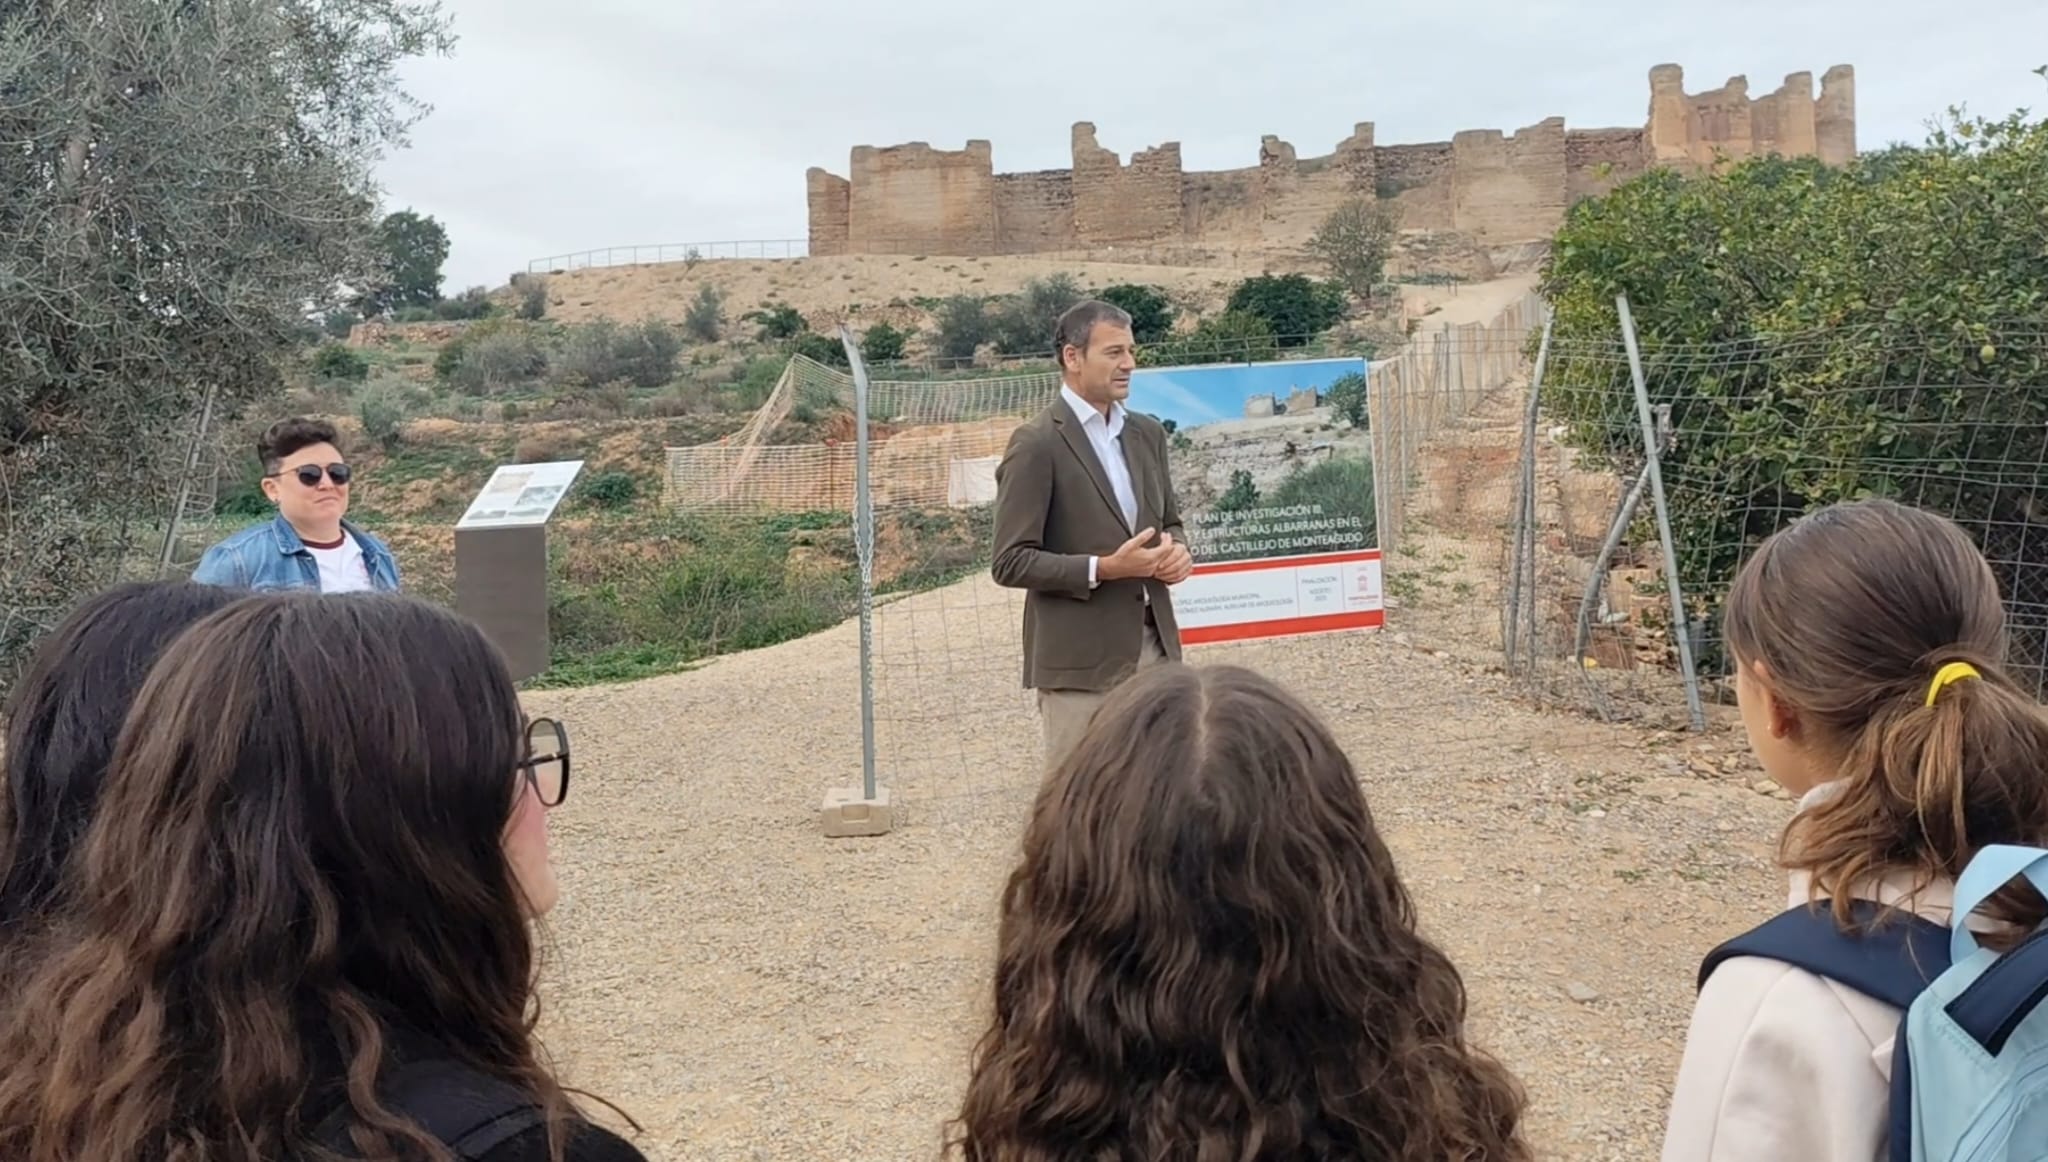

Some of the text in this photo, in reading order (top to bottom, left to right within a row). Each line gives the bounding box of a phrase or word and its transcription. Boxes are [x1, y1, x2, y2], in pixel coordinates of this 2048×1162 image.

[1192, 511, 1218, 524] PLAN
[1220, 510, 1235, 522] DE
[1235, 503, 1311, 520] INVESTIGACIÓN
[1192, 516, 1362, 539] Y ESTRUCTURAS ALBARRANAS EN EL
[1200, 543, 1218, 555] DEL
[1220, 538, 1277, 554] CASTILLEJO
[1278, 537, 1291, 549] DE
[1292, 531, 1363, 548] MONTEAGUDO
